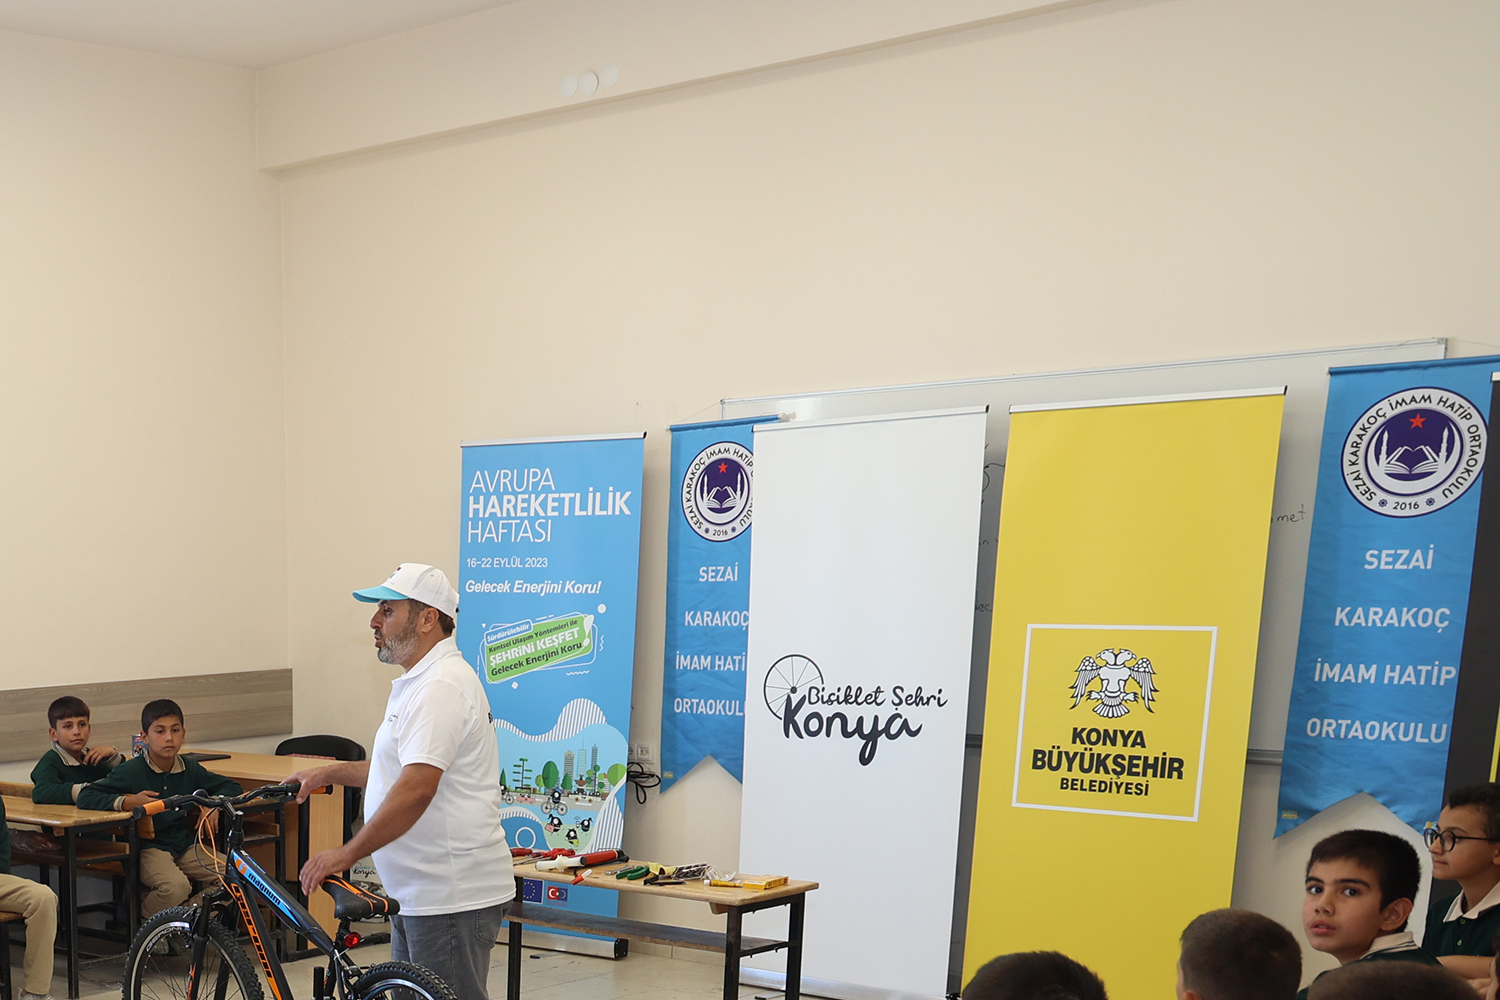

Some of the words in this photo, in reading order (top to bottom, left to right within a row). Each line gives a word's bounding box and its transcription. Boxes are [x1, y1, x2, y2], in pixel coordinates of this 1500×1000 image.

[1387, 394, 1432, 411] İMAM
[1436, 395, 1473, 421] HATİP
[1348, 407, 1387, 467] KARAKOÇ
[1441, 424, 1482, 499] ORTAOKULU
[469, 467, 556, 493] AVRUPA
[1346, 469, 1377, 502] SEZAİ
[468, 486, 632, 518] HAREKETLİLİK
[1393, 501, 1420, 511] 2016
[468, 519, 552, 543] HAFTASI
[712, 529, 728, 537] 2016
[493, 556, 523, 568] EYLÜL
[525, 557, 549, 568] 2023
[1363, 544, 1435, 570] SEZAİ
[699, 562, 739, 582] SEZAİ
[465, 580, 511, 593] Gelecek
[513, 580, 563, 596] Enerjini
[564, 580, 602, 594] Koru!
[684, 610, 749, 631] KARAKOÇ
[1334, 606, 1451, 634] KARAKOÇ
[489, 641, 512, 653] Kentsel
[534, 621, 569, 638] Yöntemleri
[570, 619, 578, 627] ile
[537, 627, 580, 651] KEŞFET
[491, 661, 524, 676] Gelecek
[525, 650, 560, 667] Enerjini
[560, 642, 582, 655] Koru
[675, 651, 711, 671] İMAM
[714, 652, 747, 672] HATİ
[1313, 657, 1378, 685] İMAM
[1383, 661, 1457, 687] HATİP
[673, 698, 746, 716] ORTAOKUL
[807, 685, 887, 707] Bisiklet
[891, 685, 949, 711] Şehri
[783, 694, 924, 767] Konya
[1071, 727, 1147, 749] KONYA
[1306, 717, 1448, 744] ORTAOKULU
[1031, 745, 1185, 780] BÜYÜKŞEHİR
[1060, 777, 1150, 797] BELEDİYESİ
[248, 872, 281, 906] magnum
